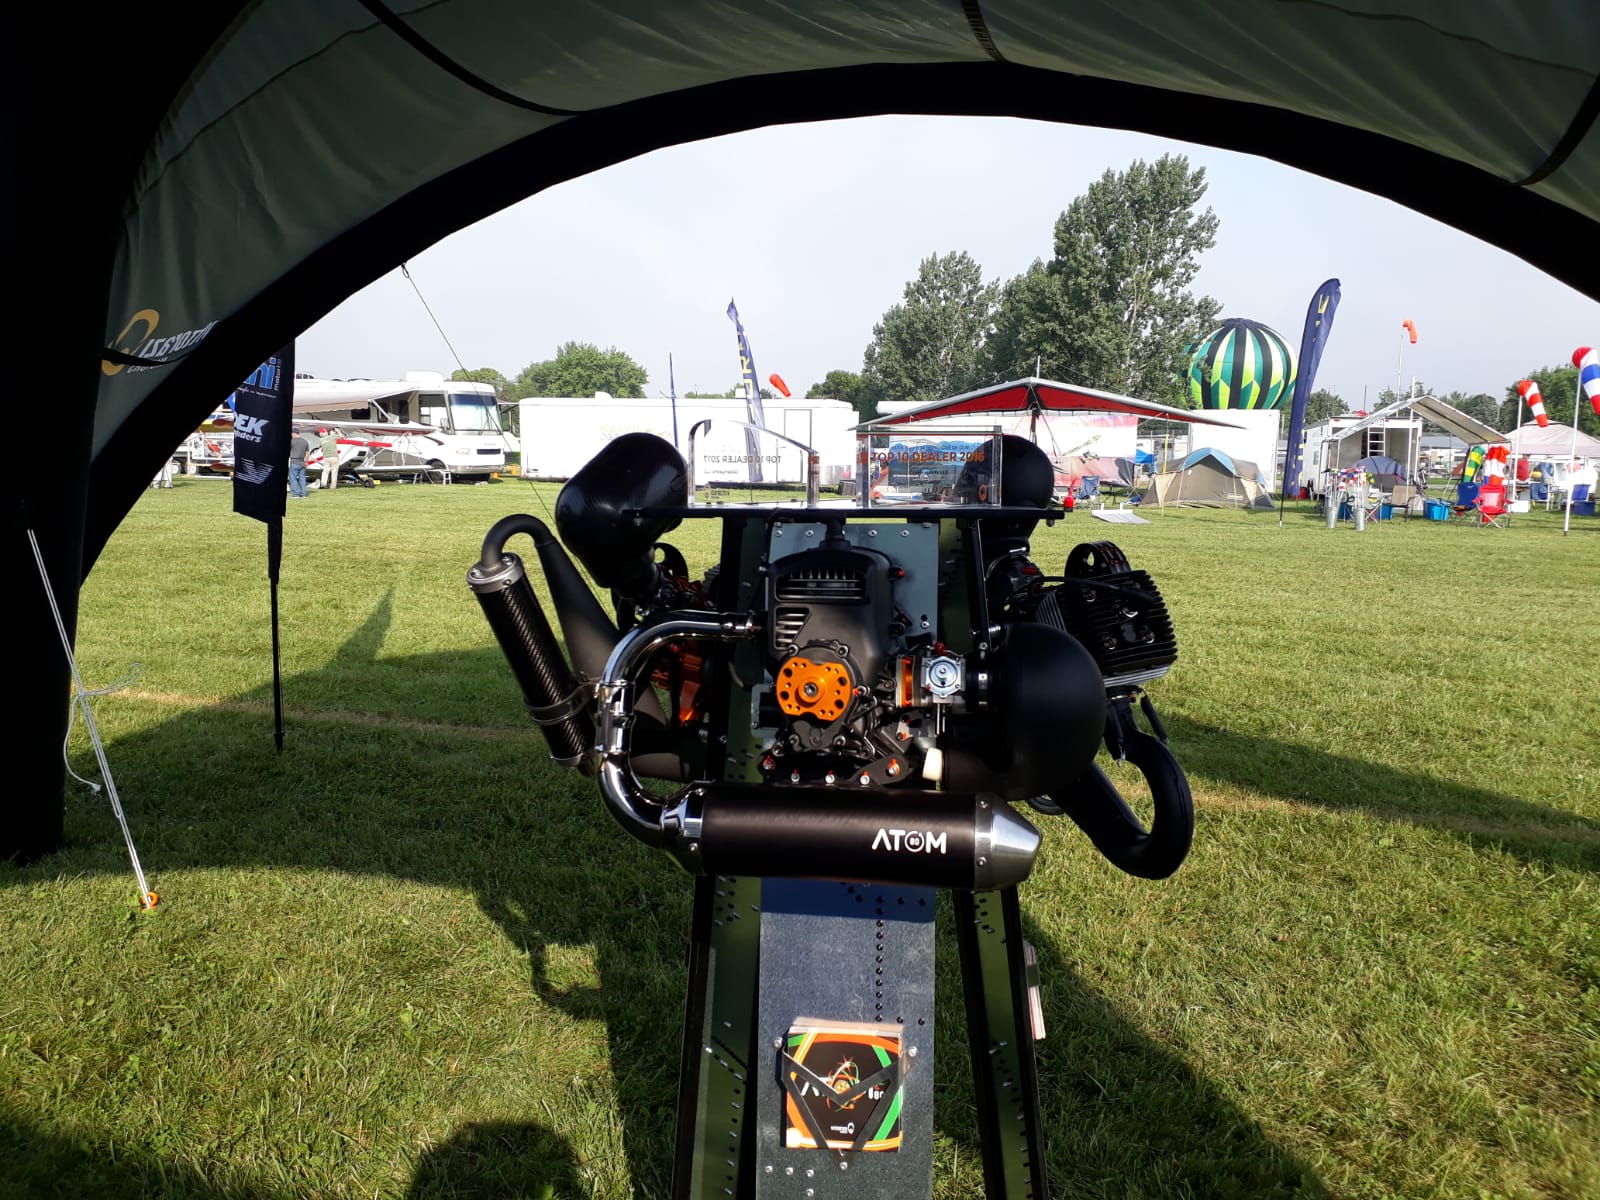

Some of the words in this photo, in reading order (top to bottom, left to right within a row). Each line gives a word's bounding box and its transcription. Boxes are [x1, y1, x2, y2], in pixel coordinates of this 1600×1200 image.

[872, 451, 895, 463] TOP
[912, 451, 957, 463] DEALER
[872, 828, 947, 854] ATOM
